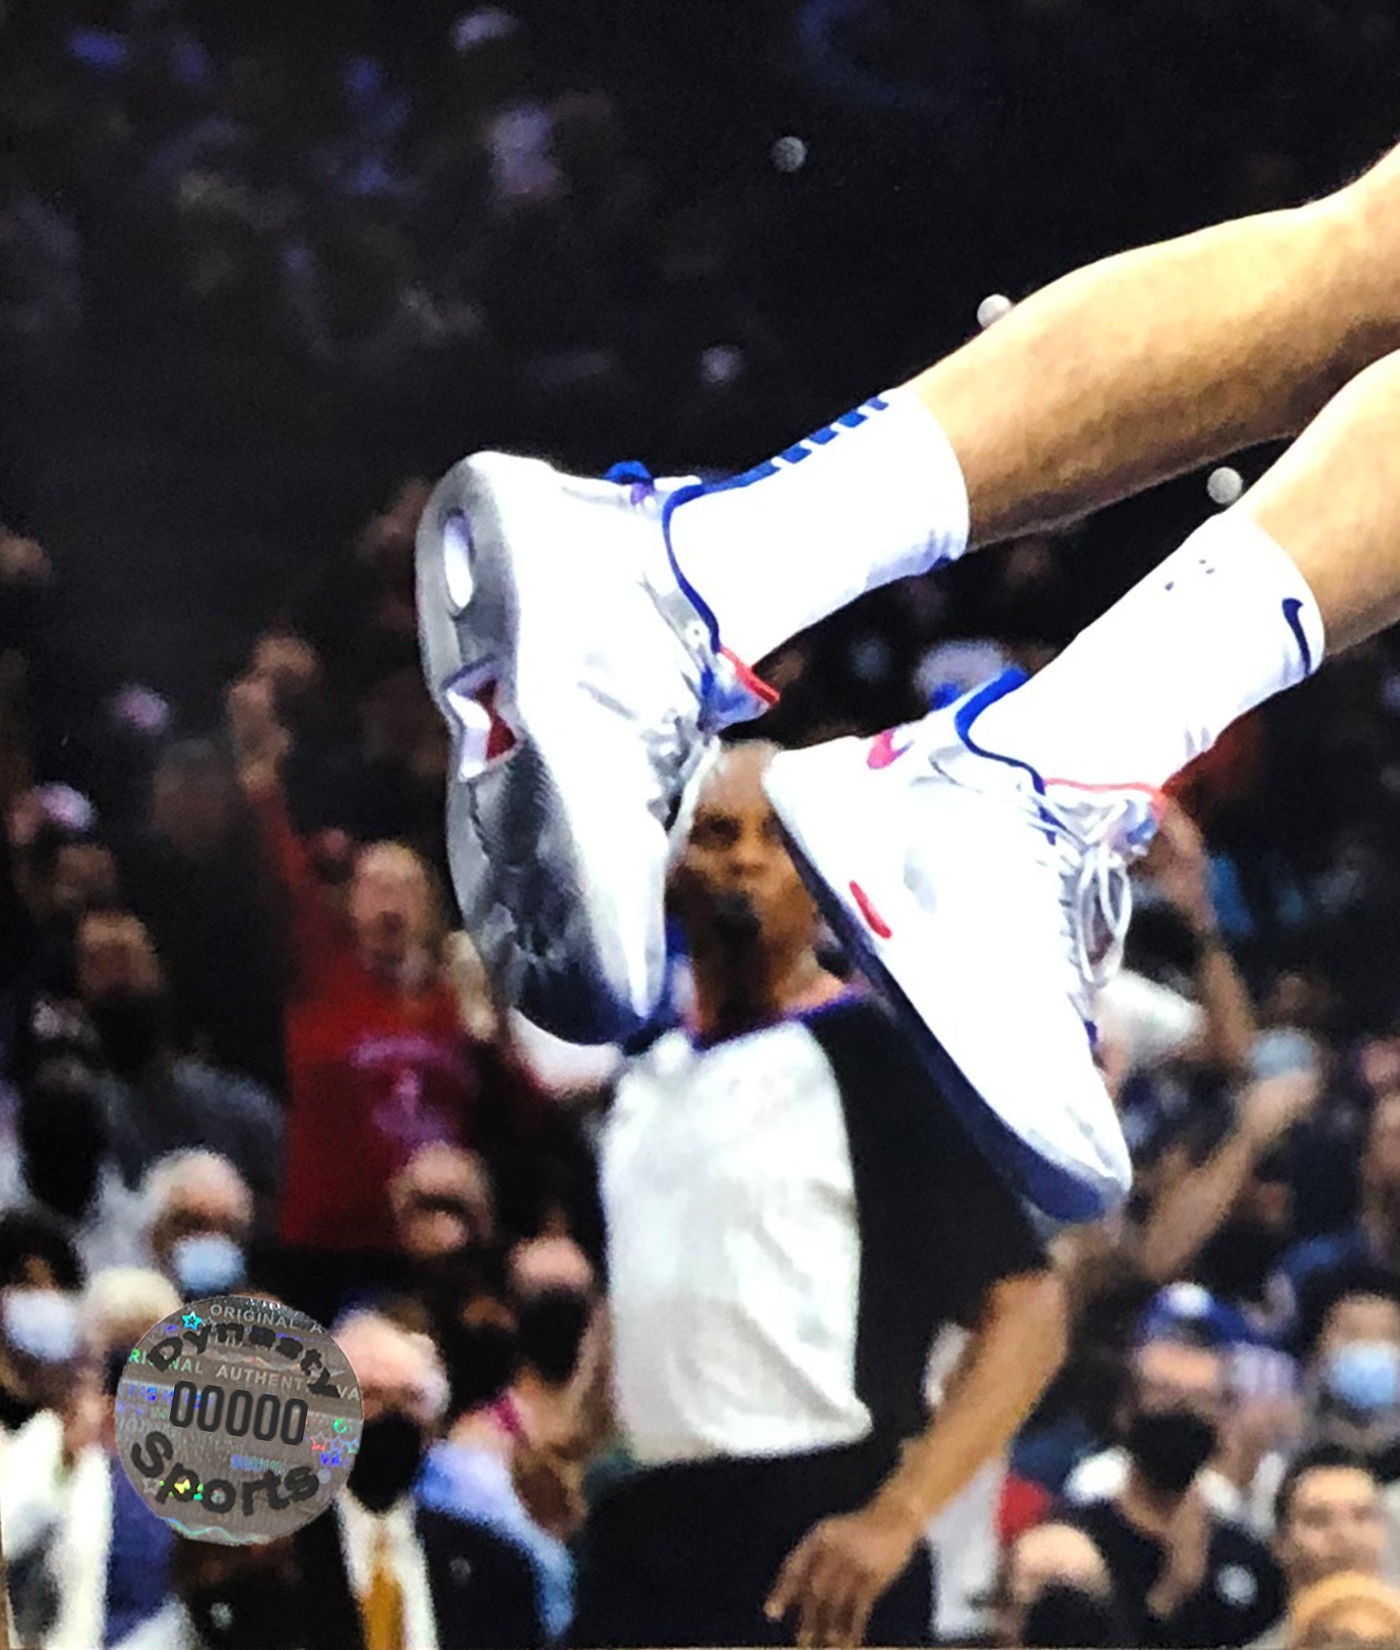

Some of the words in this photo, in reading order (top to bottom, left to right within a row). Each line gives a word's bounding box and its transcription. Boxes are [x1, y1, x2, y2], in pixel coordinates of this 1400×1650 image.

[210, 1303, 300, 1331] ORIGINAL
[146, 1323, 341, 1399] Dynasty
[216, 1363, 317, 1397] AUTHENT
[169, 1380, 309, 1447] 00000
[130, 1430, 320, 1517] Sports
